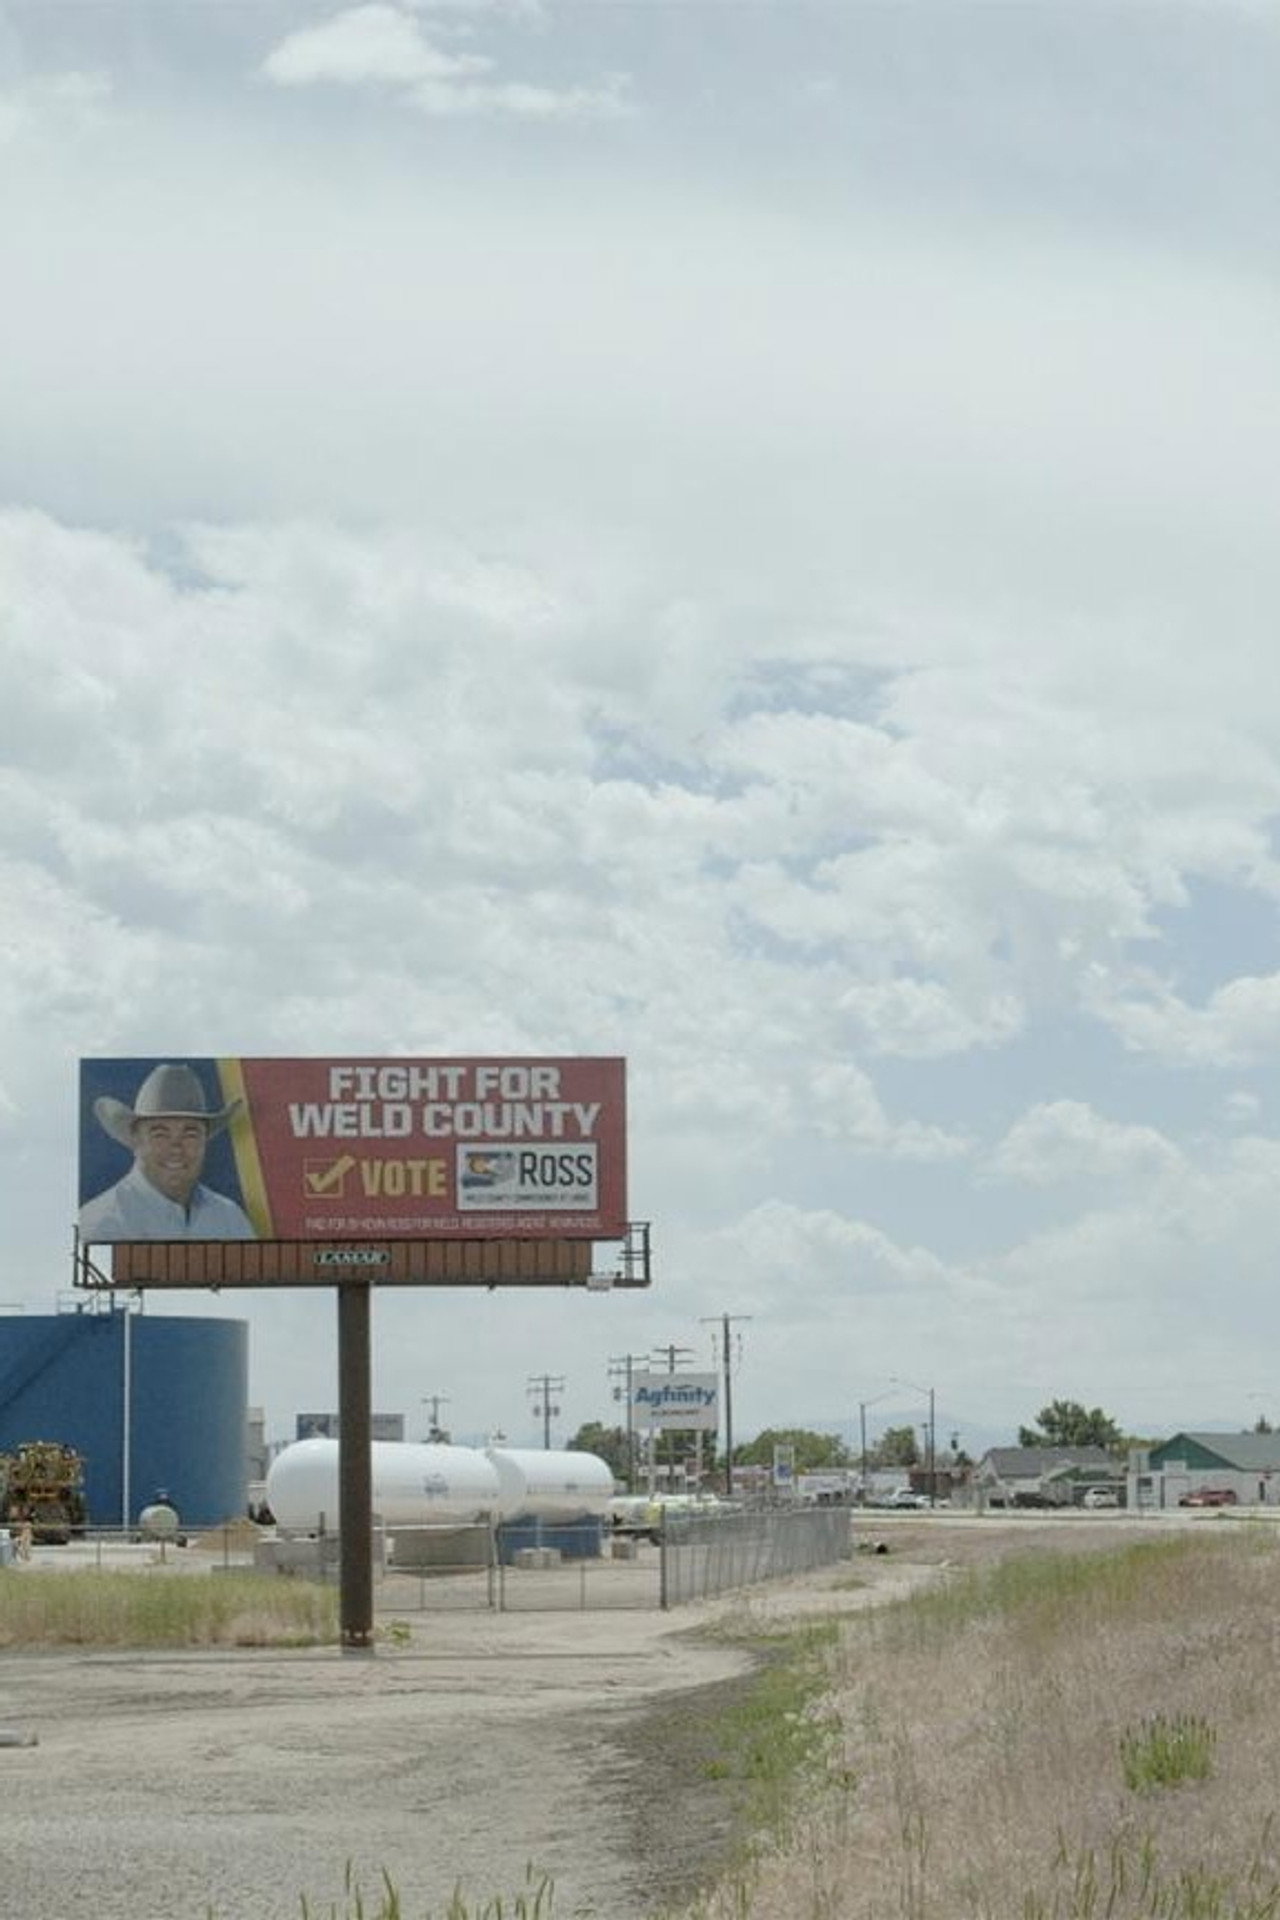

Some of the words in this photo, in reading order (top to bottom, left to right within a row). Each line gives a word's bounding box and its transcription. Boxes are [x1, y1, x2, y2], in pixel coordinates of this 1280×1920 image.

[329, 1066, 466, 1101] FIGHT
[475, 1066, 561, 1100] FOR
[289, 1103, 412, 1138] WELD
[423, 1102, 600, 1137] COUNTY
[361, 1159, 447, 1197] VOTE
[519, 1151, 593, 1187] ROSS
[635, 1385, 716, 1408] Agfinity
